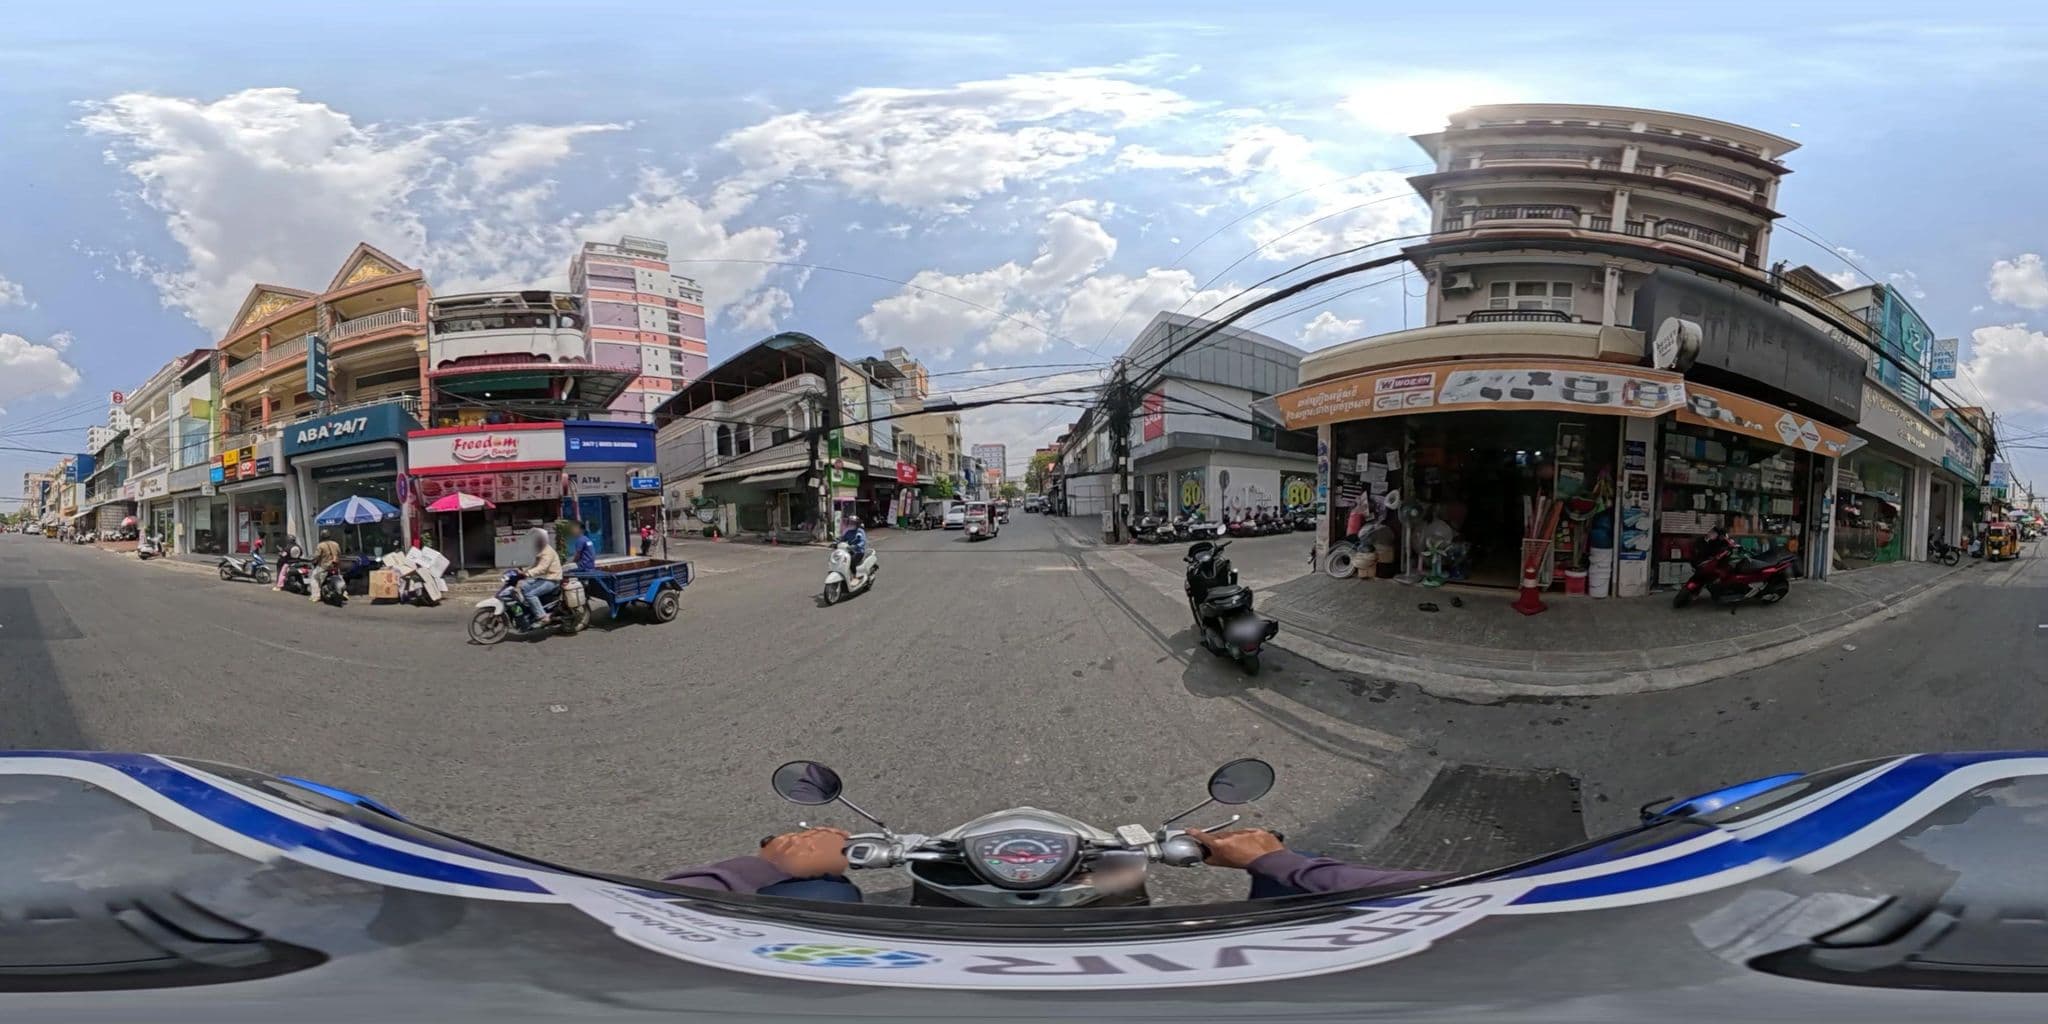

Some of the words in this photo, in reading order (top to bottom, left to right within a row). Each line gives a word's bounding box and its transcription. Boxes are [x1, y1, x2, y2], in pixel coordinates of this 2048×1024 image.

[297, 425, 330, 444] ABA
[334, 417, 367, 436] 24/7
[582, 476, 601, 484] ATM
[1182, 480, 1200, 507] 80
[1287, 480, 1312, 507] 80
[616, 911, 717, 943] Global
[962, 893, 1495, 976] SERVIR
